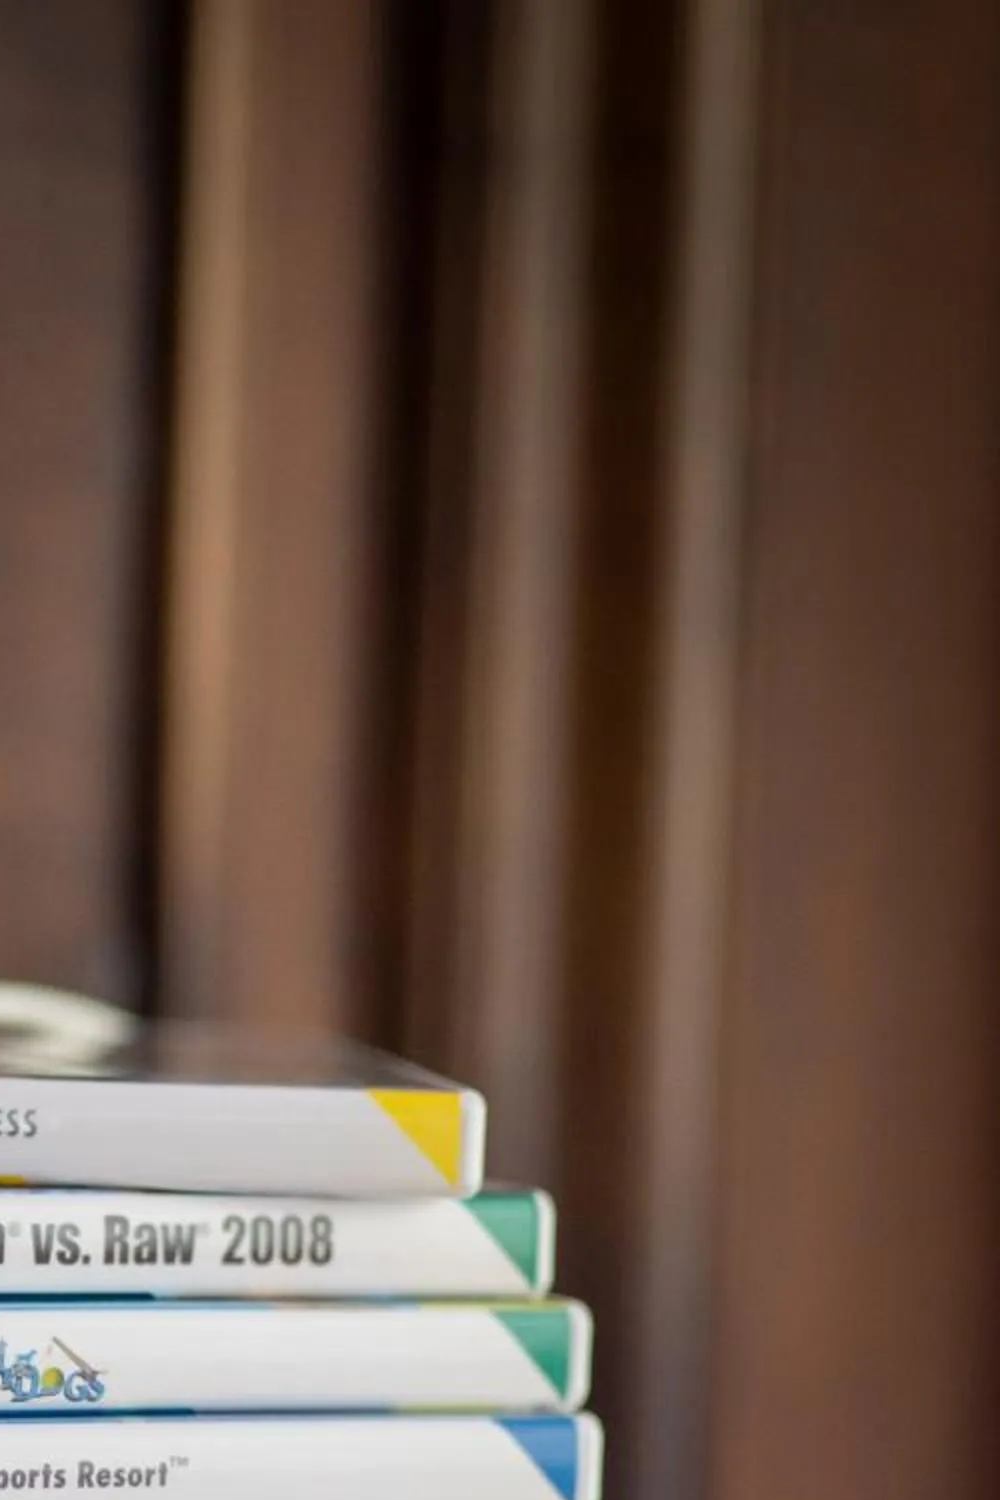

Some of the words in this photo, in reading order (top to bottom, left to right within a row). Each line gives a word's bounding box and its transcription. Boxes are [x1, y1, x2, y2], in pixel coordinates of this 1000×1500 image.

[31, 1222, 91, 1266] vs.
[103, 1214, 197, 1266] Raw
[220, 1214, 334, 1267] 2008
